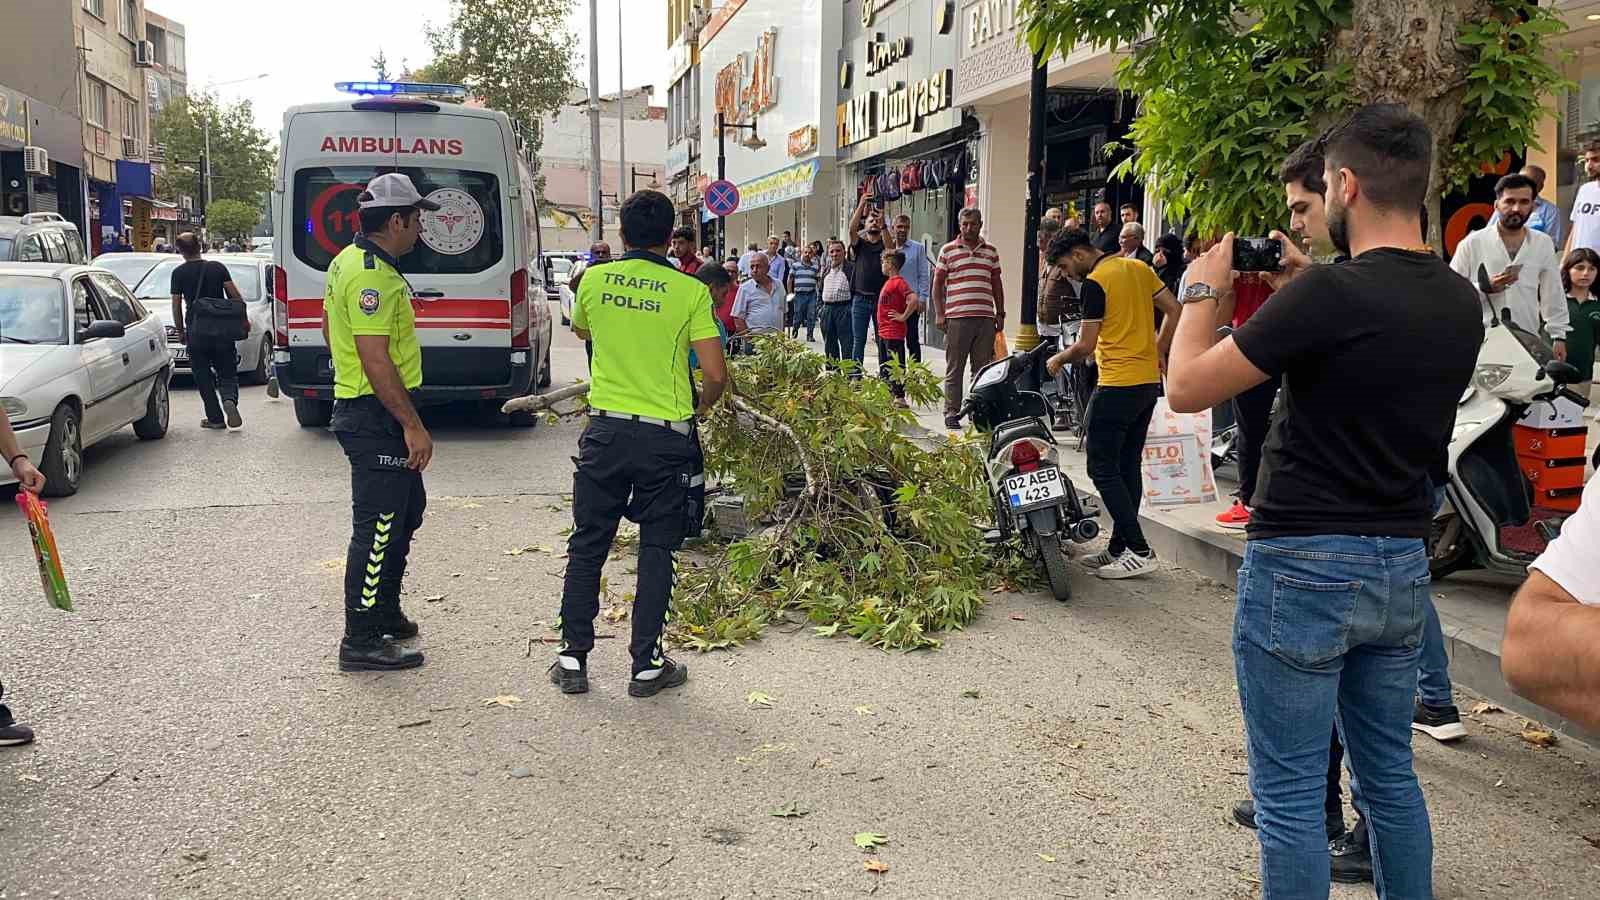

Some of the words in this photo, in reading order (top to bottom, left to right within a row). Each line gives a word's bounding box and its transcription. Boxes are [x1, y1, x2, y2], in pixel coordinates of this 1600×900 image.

[320, 136, 464, 156] AMBULANS
[1008, 476, 1026, 490] 02
[1029, 469, 1058, 486] AEB
[1025, 486, 1050, 501] 423
